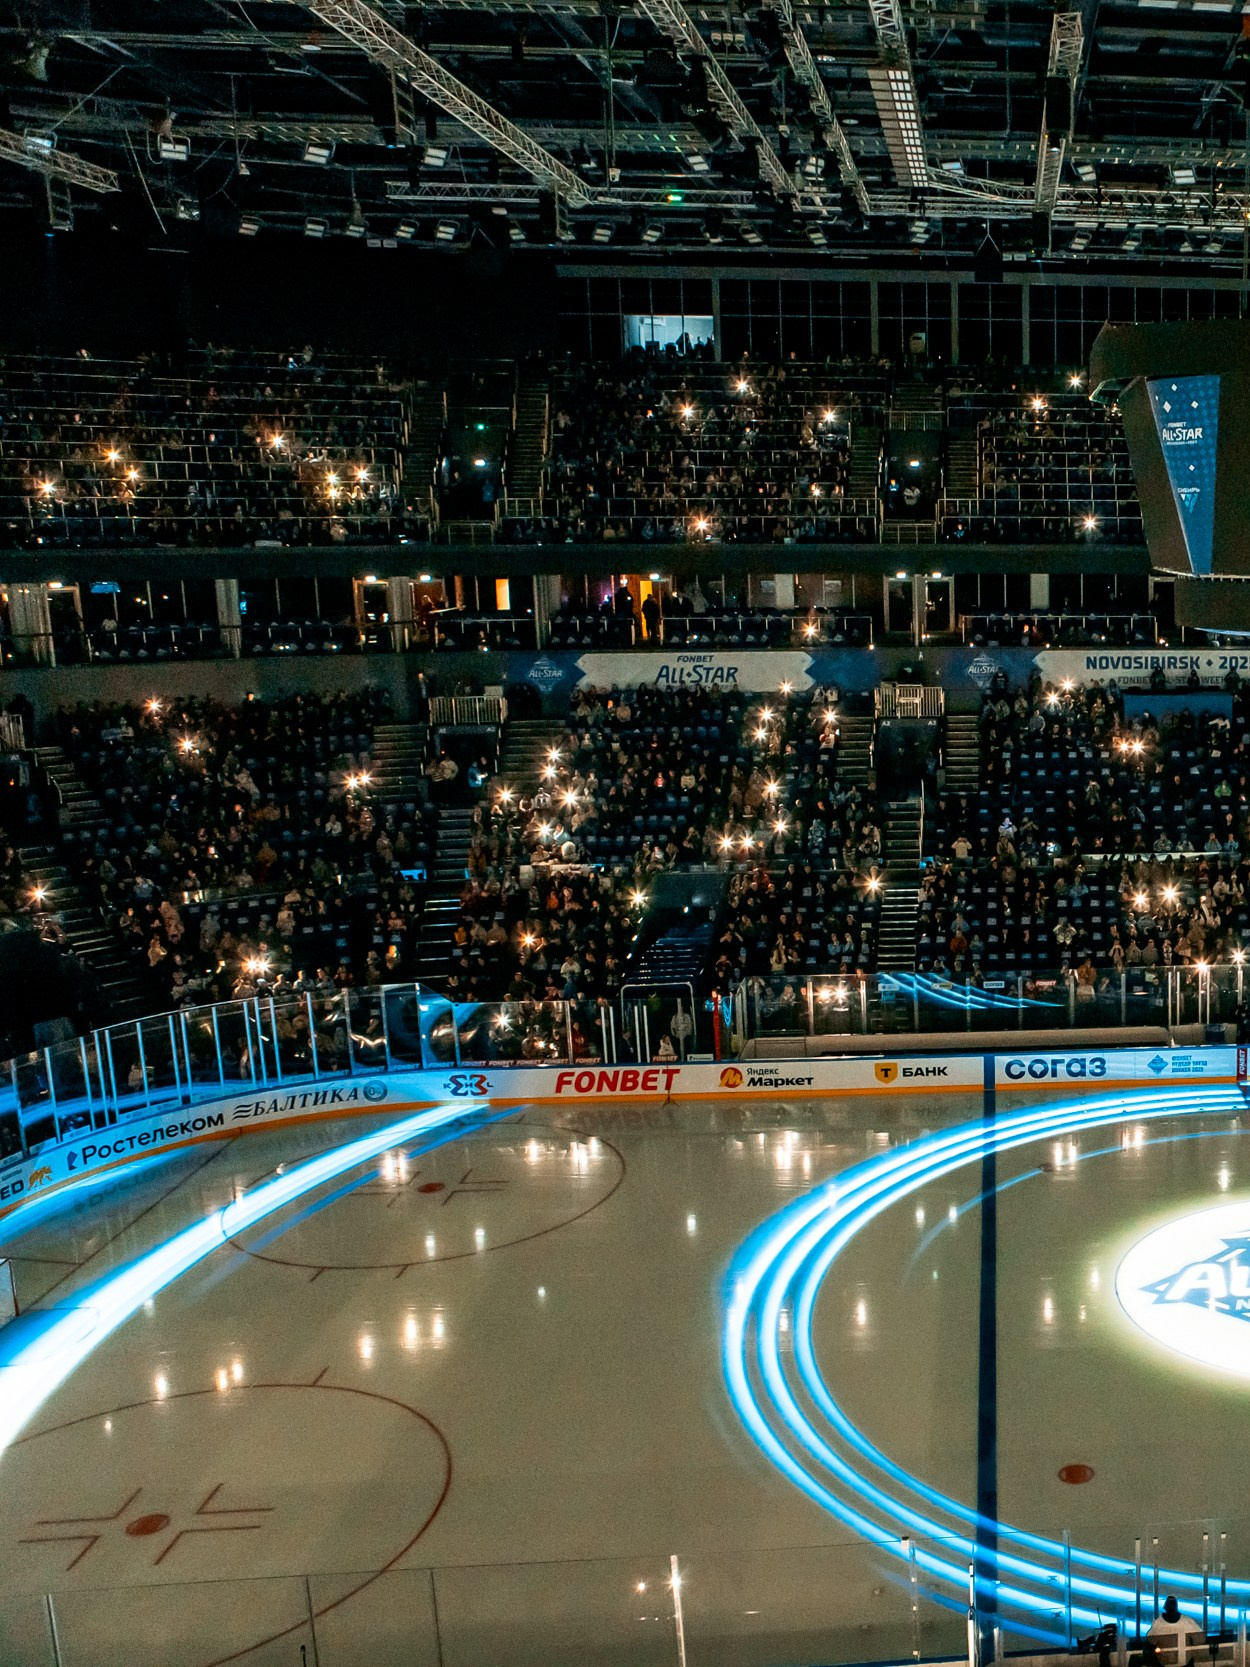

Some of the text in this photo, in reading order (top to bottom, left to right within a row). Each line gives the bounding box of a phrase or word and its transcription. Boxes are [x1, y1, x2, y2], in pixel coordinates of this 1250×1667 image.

[677, 655, 714, 663] FONBET
[1086, 656, 1200, 670] NOVOSIBIRSK
[746, 1067, 779, 1076] Яндекс
[902, 1066, 948, 1077] БАНК
[555, 1069, 680, 1093] FONBET
[747, 1076, 814, 1088] Маркет
[253, 1087, 359, 1119] БАЛТИКА
[82, 1112, 224, 1165] Ростелеком
